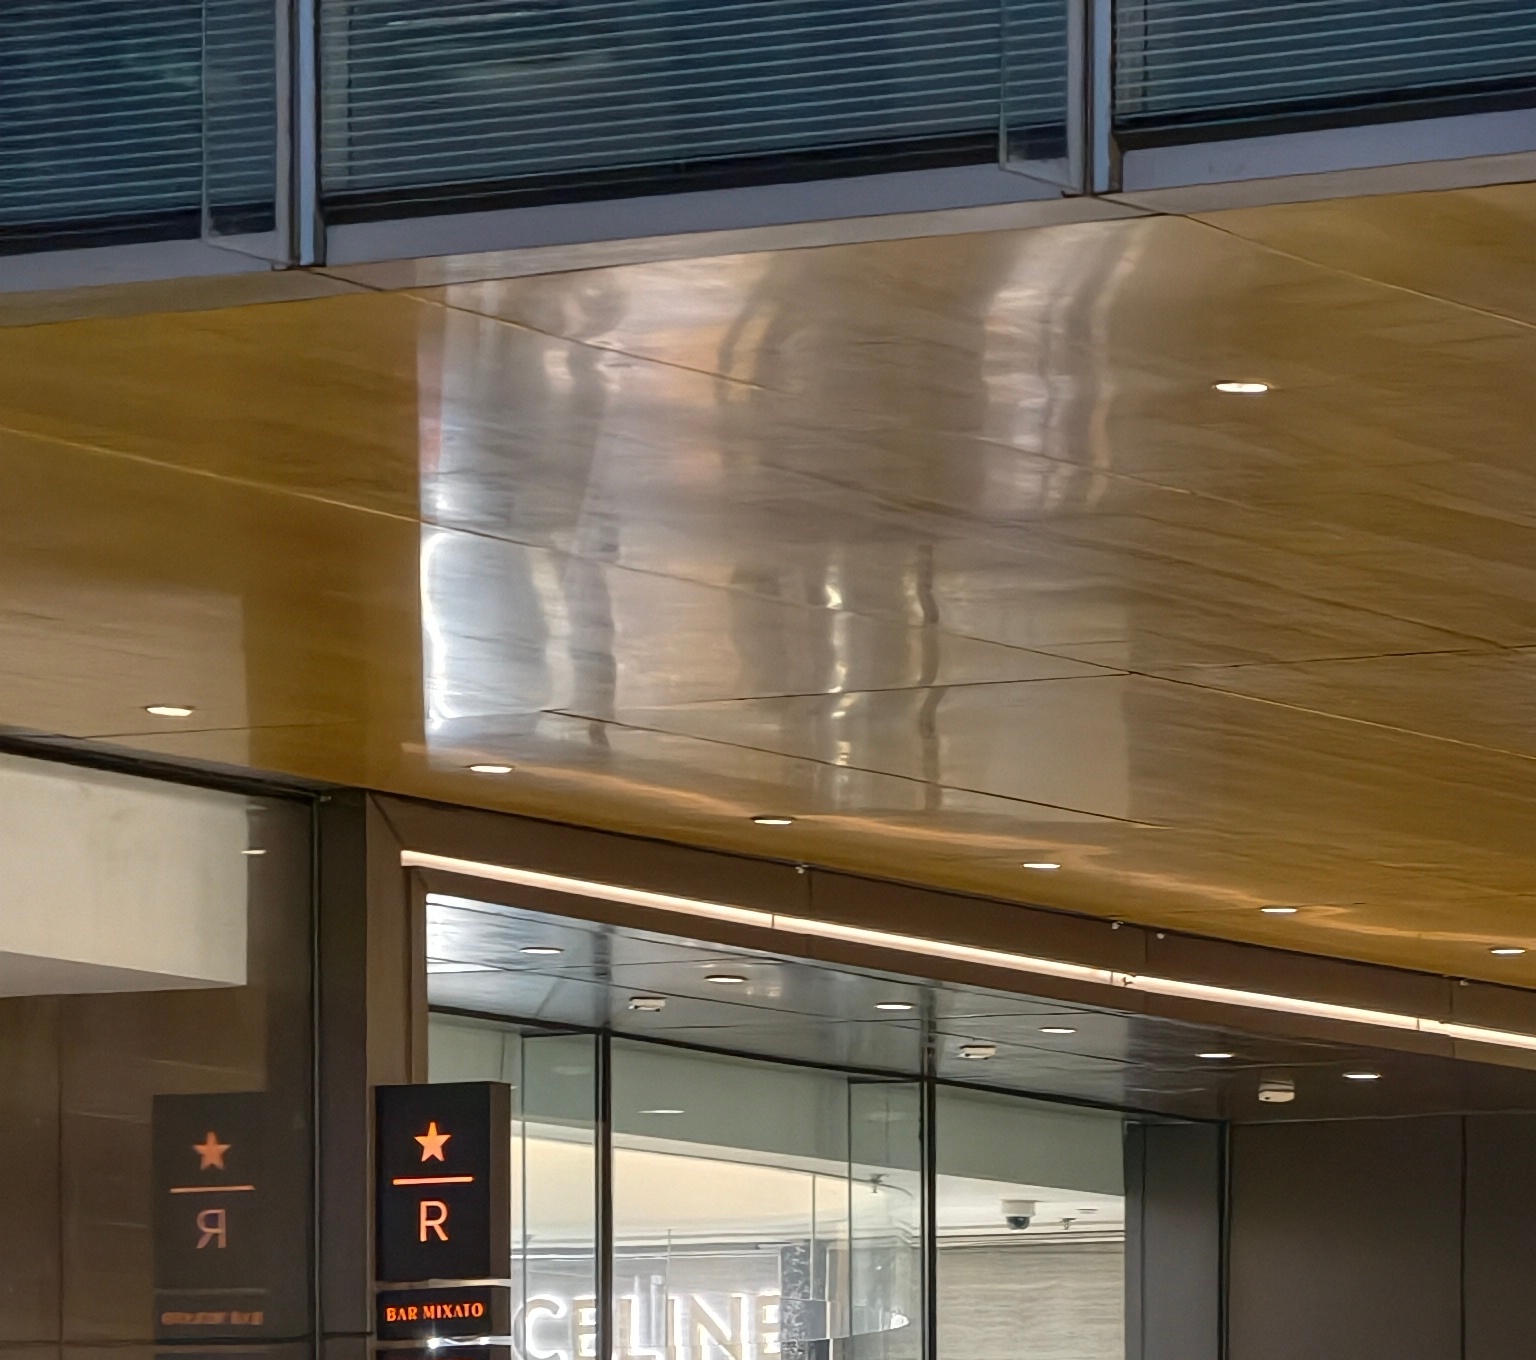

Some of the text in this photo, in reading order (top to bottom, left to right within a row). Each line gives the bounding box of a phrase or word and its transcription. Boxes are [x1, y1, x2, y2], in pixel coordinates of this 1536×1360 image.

[419, 1200, 449, 1242] R
[386, 1303, 484, 1322] BAR MIXATO
